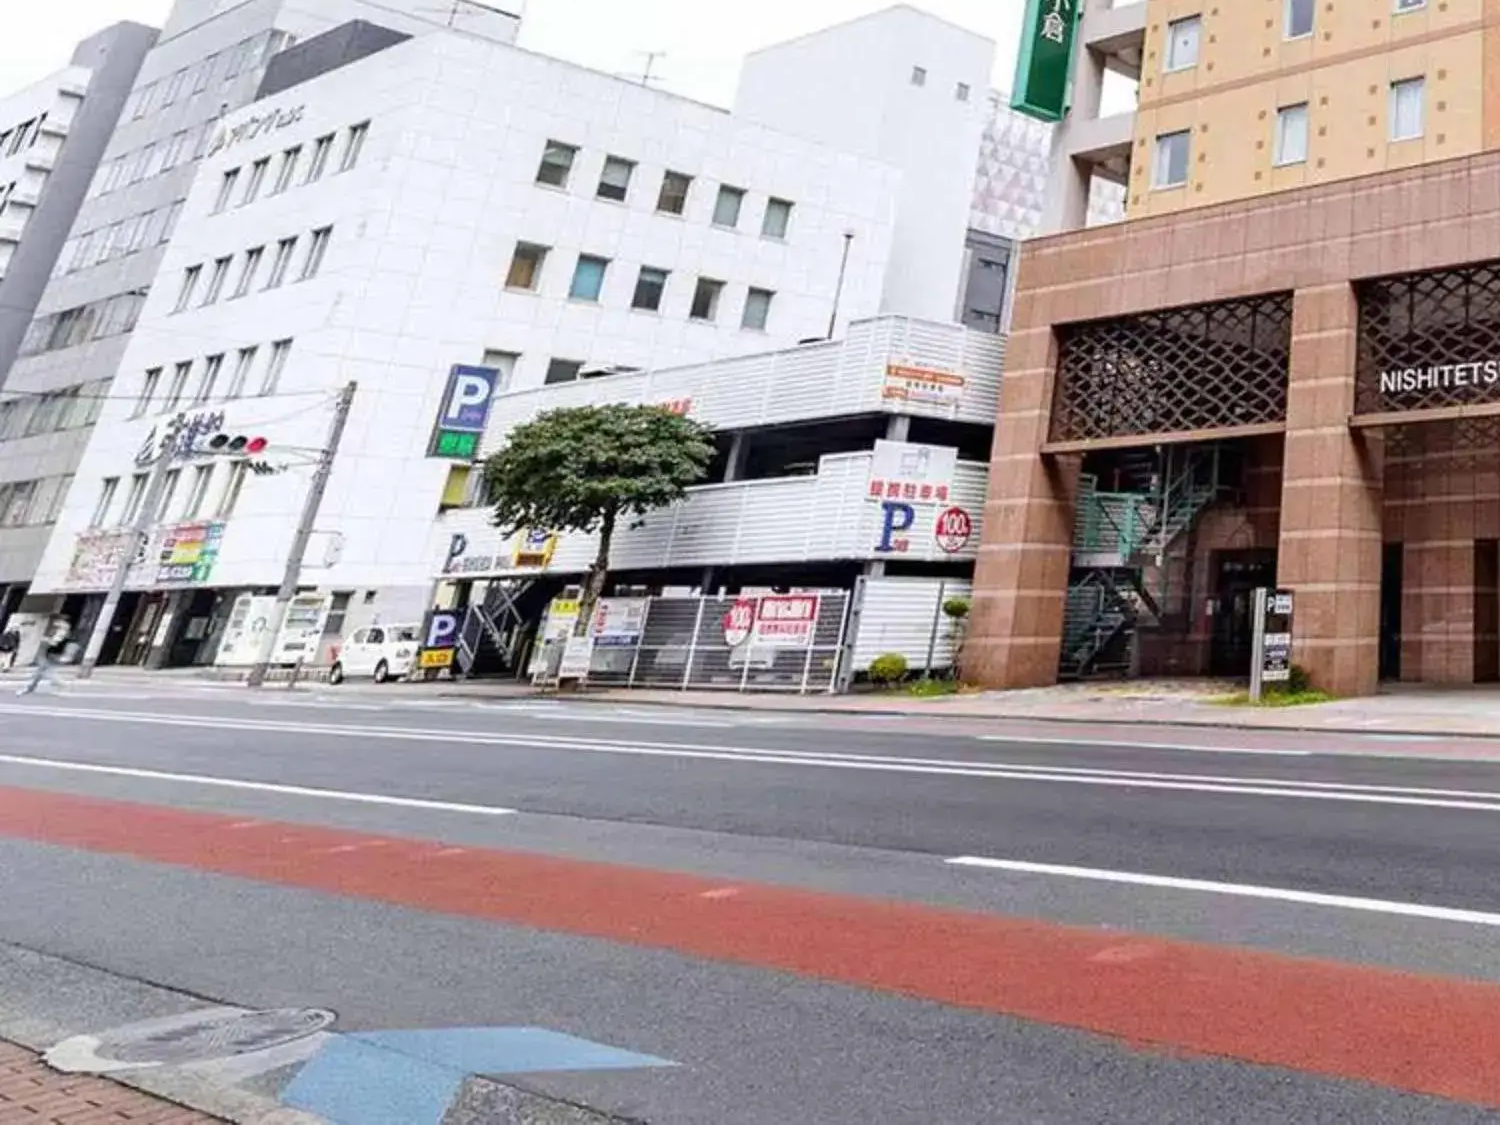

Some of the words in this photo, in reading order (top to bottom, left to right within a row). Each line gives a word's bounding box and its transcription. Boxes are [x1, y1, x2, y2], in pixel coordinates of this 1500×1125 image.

[447, 374, 490, 419] P
[874, 501, 915, 552] P
[427, 614, 457, 647] P
